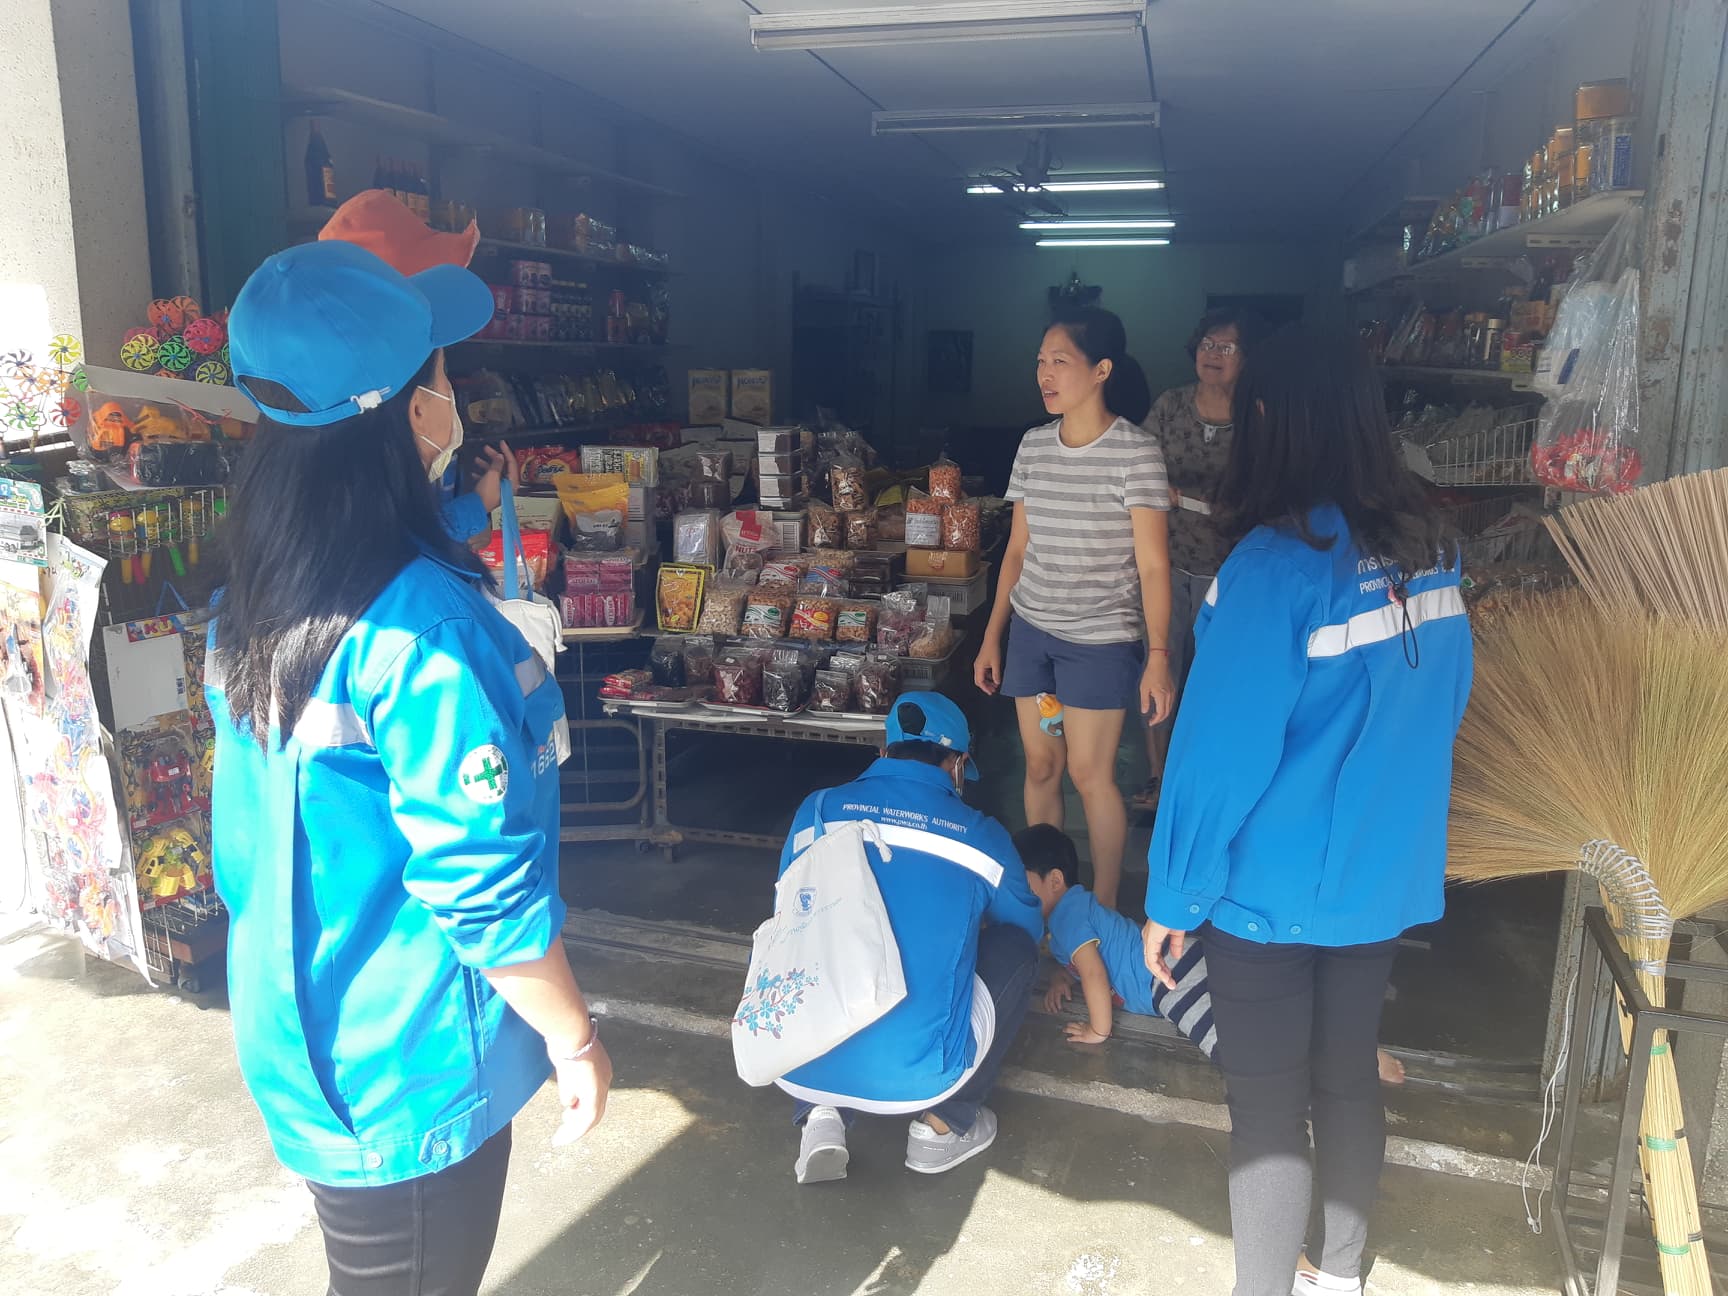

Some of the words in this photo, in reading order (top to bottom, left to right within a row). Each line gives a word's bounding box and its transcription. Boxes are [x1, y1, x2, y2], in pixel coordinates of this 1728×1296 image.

[531, 742, 556, 780] 1662
[842, 803, 880, 813] PROVINCIAL
[882, 807, 928, 823] WATERWORKS
[931, 817, 968, 834] AUTHORITY
